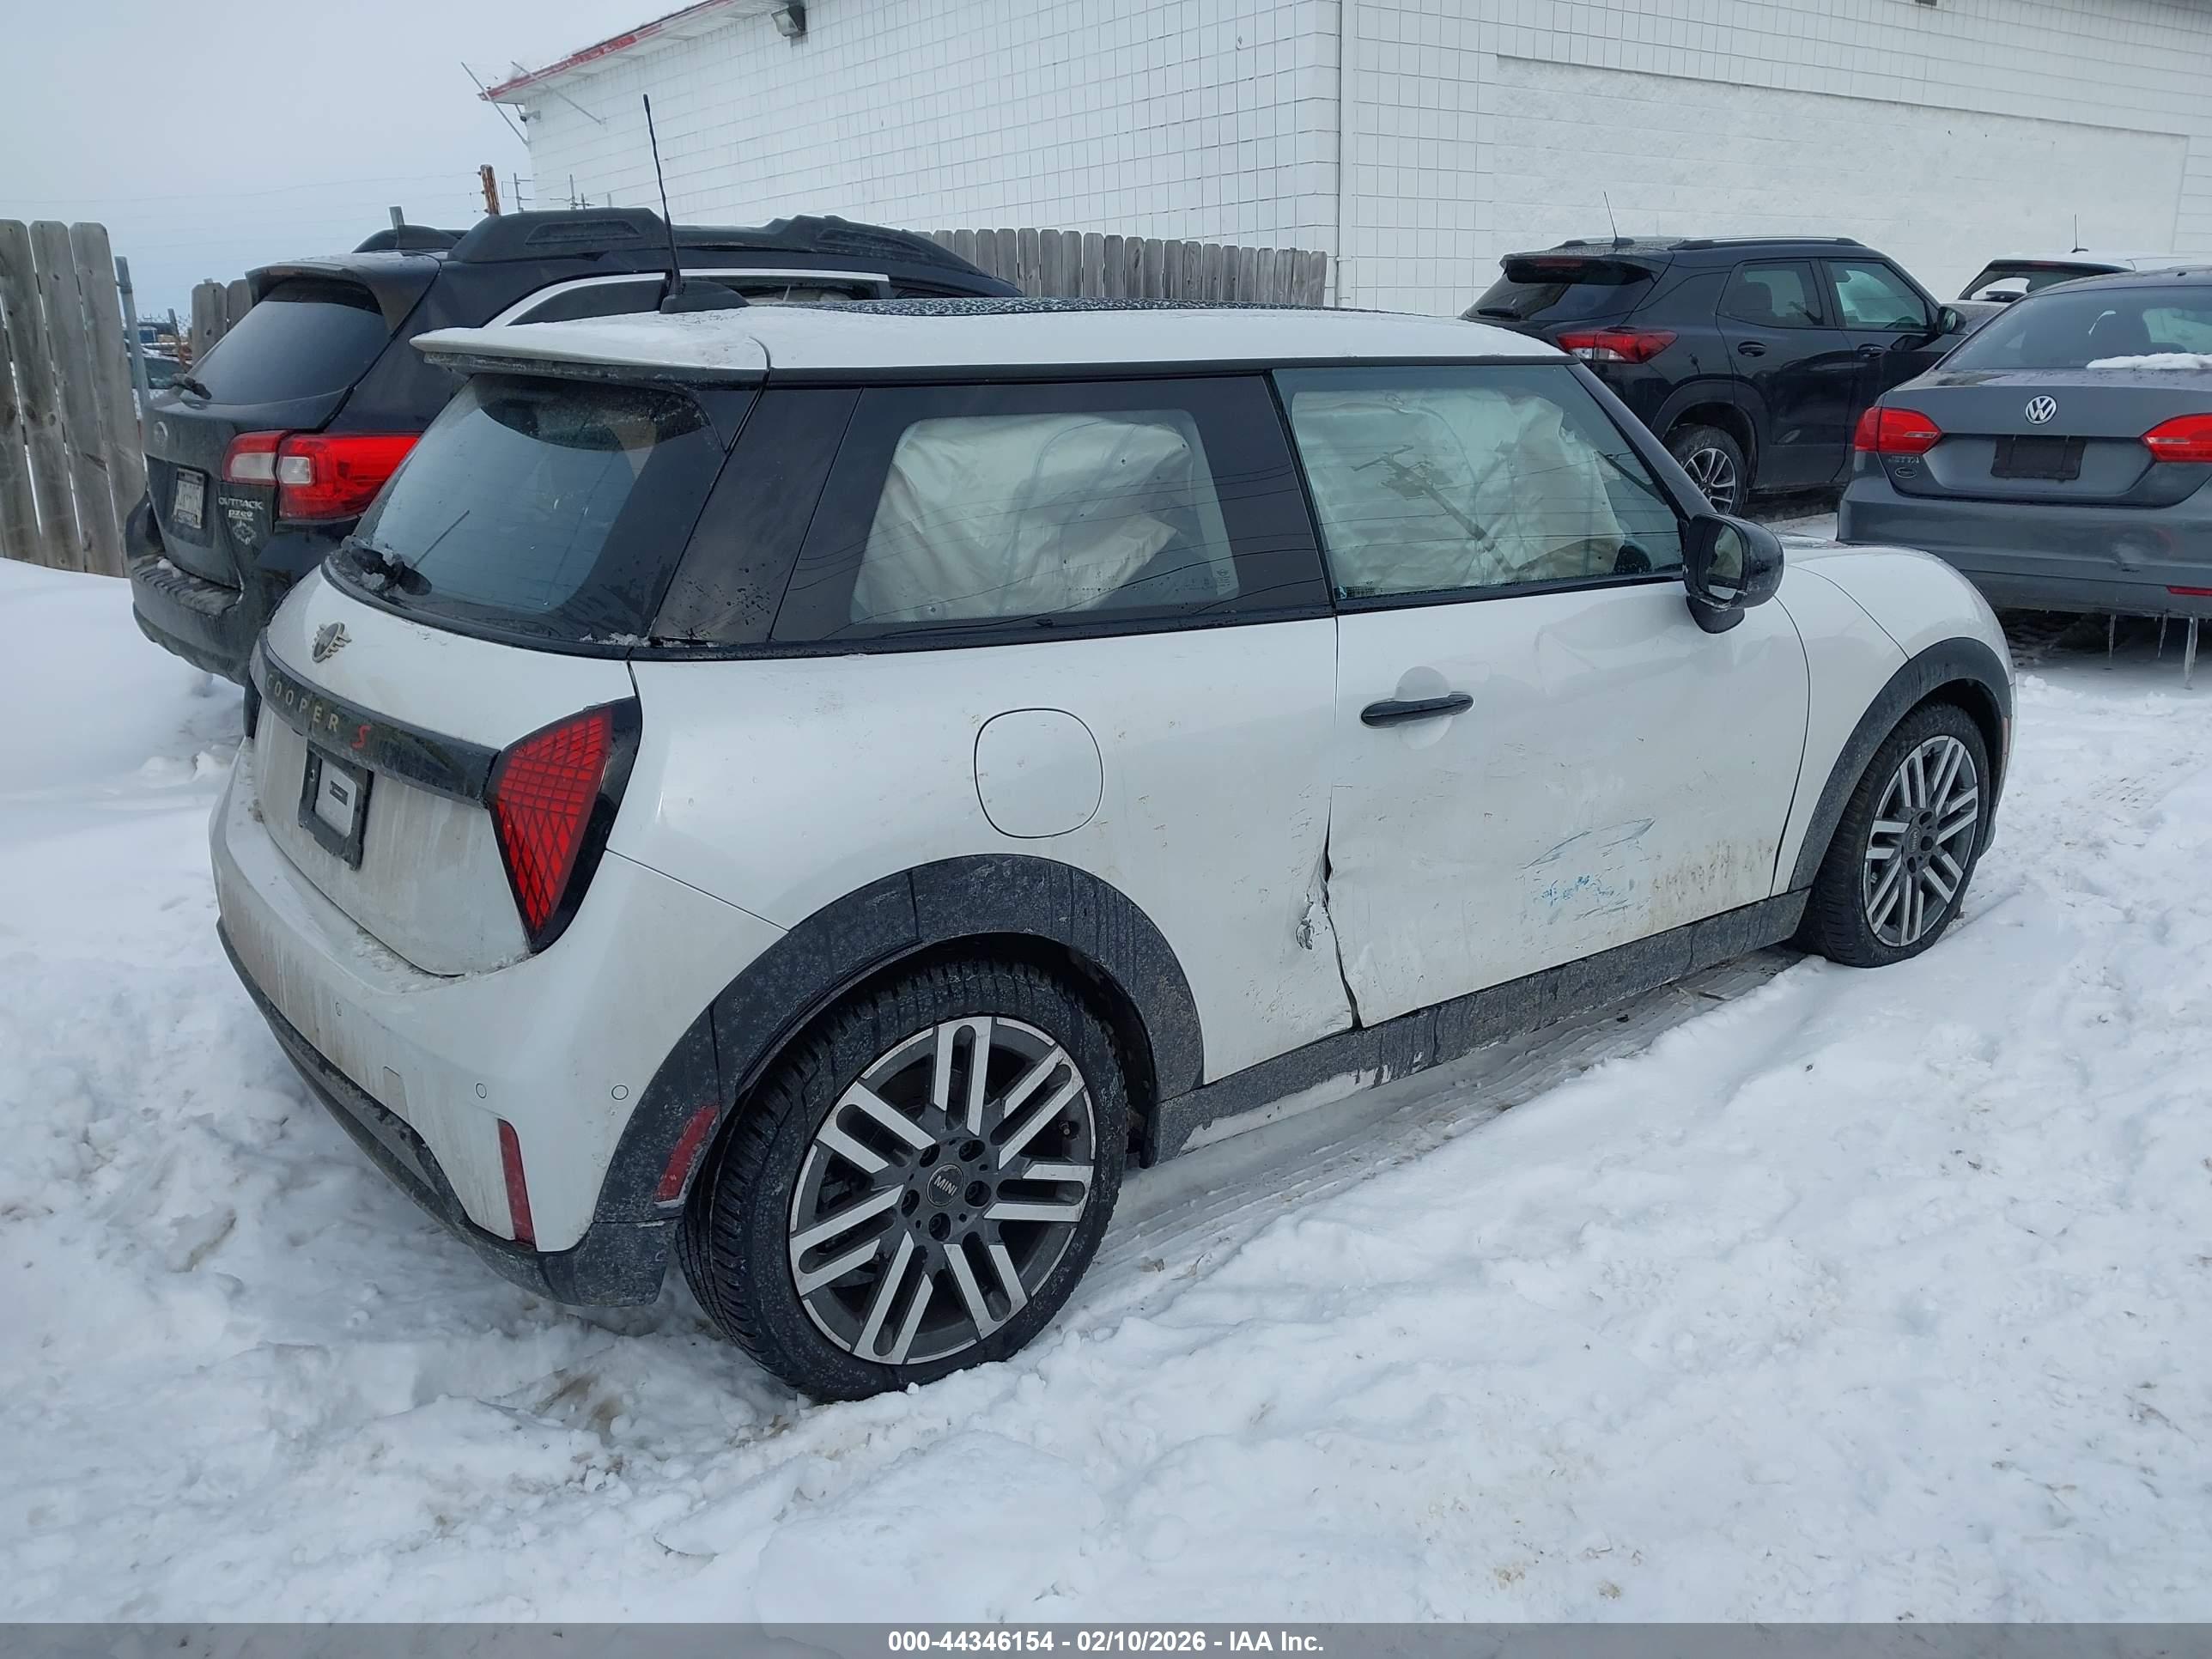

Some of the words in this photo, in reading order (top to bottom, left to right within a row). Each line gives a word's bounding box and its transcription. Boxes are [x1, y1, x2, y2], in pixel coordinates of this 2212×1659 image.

[2025, 394, 2057, 425] VW
[264, 672, 340, 733] COOPER
[350, 724, 371, 750] S
[934, 1176, 957, 1196] MINI
